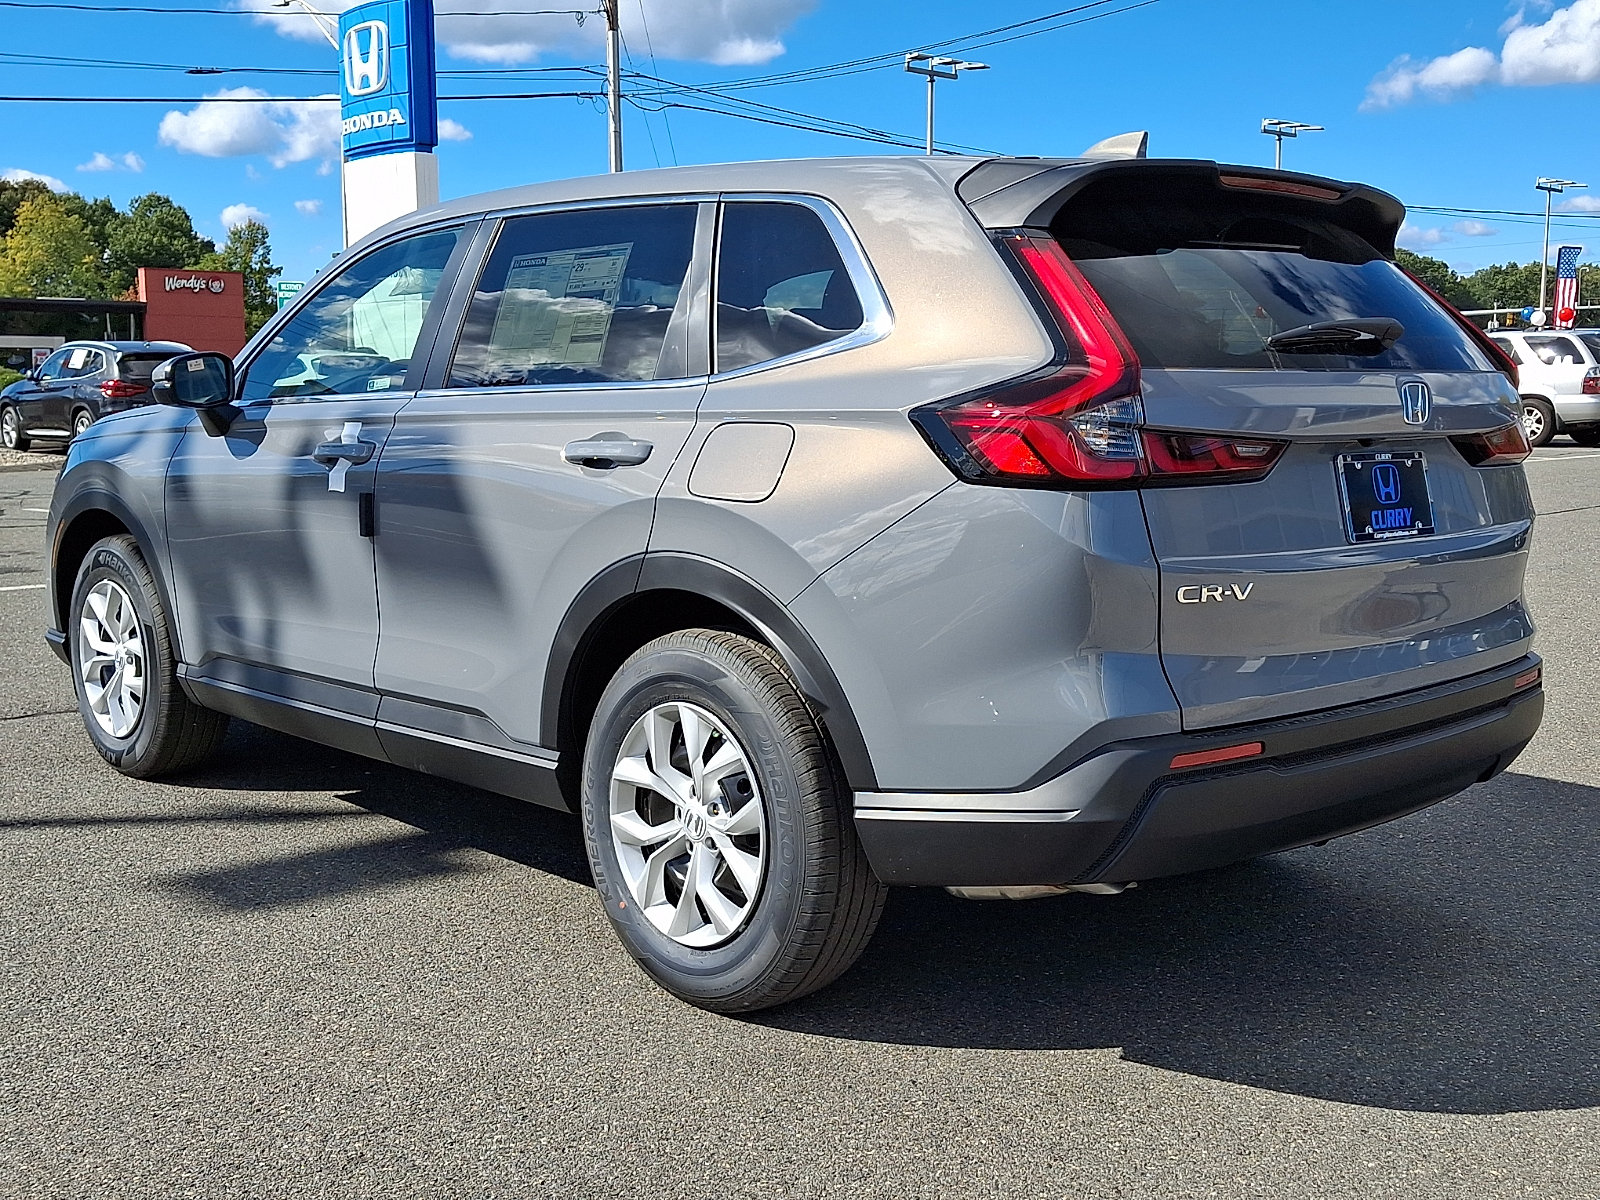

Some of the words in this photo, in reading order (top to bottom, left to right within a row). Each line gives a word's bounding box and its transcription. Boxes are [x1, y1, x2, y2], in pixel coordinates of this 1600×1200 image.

[341, 109, 406, 136] HONDA
[520, 259, 546, 268] HONDA
[165, 274, 207, 293] Wendy's
[1371, 507, 1413, 529] CURRY
[1176, 582, 1254, 604] CR-V
